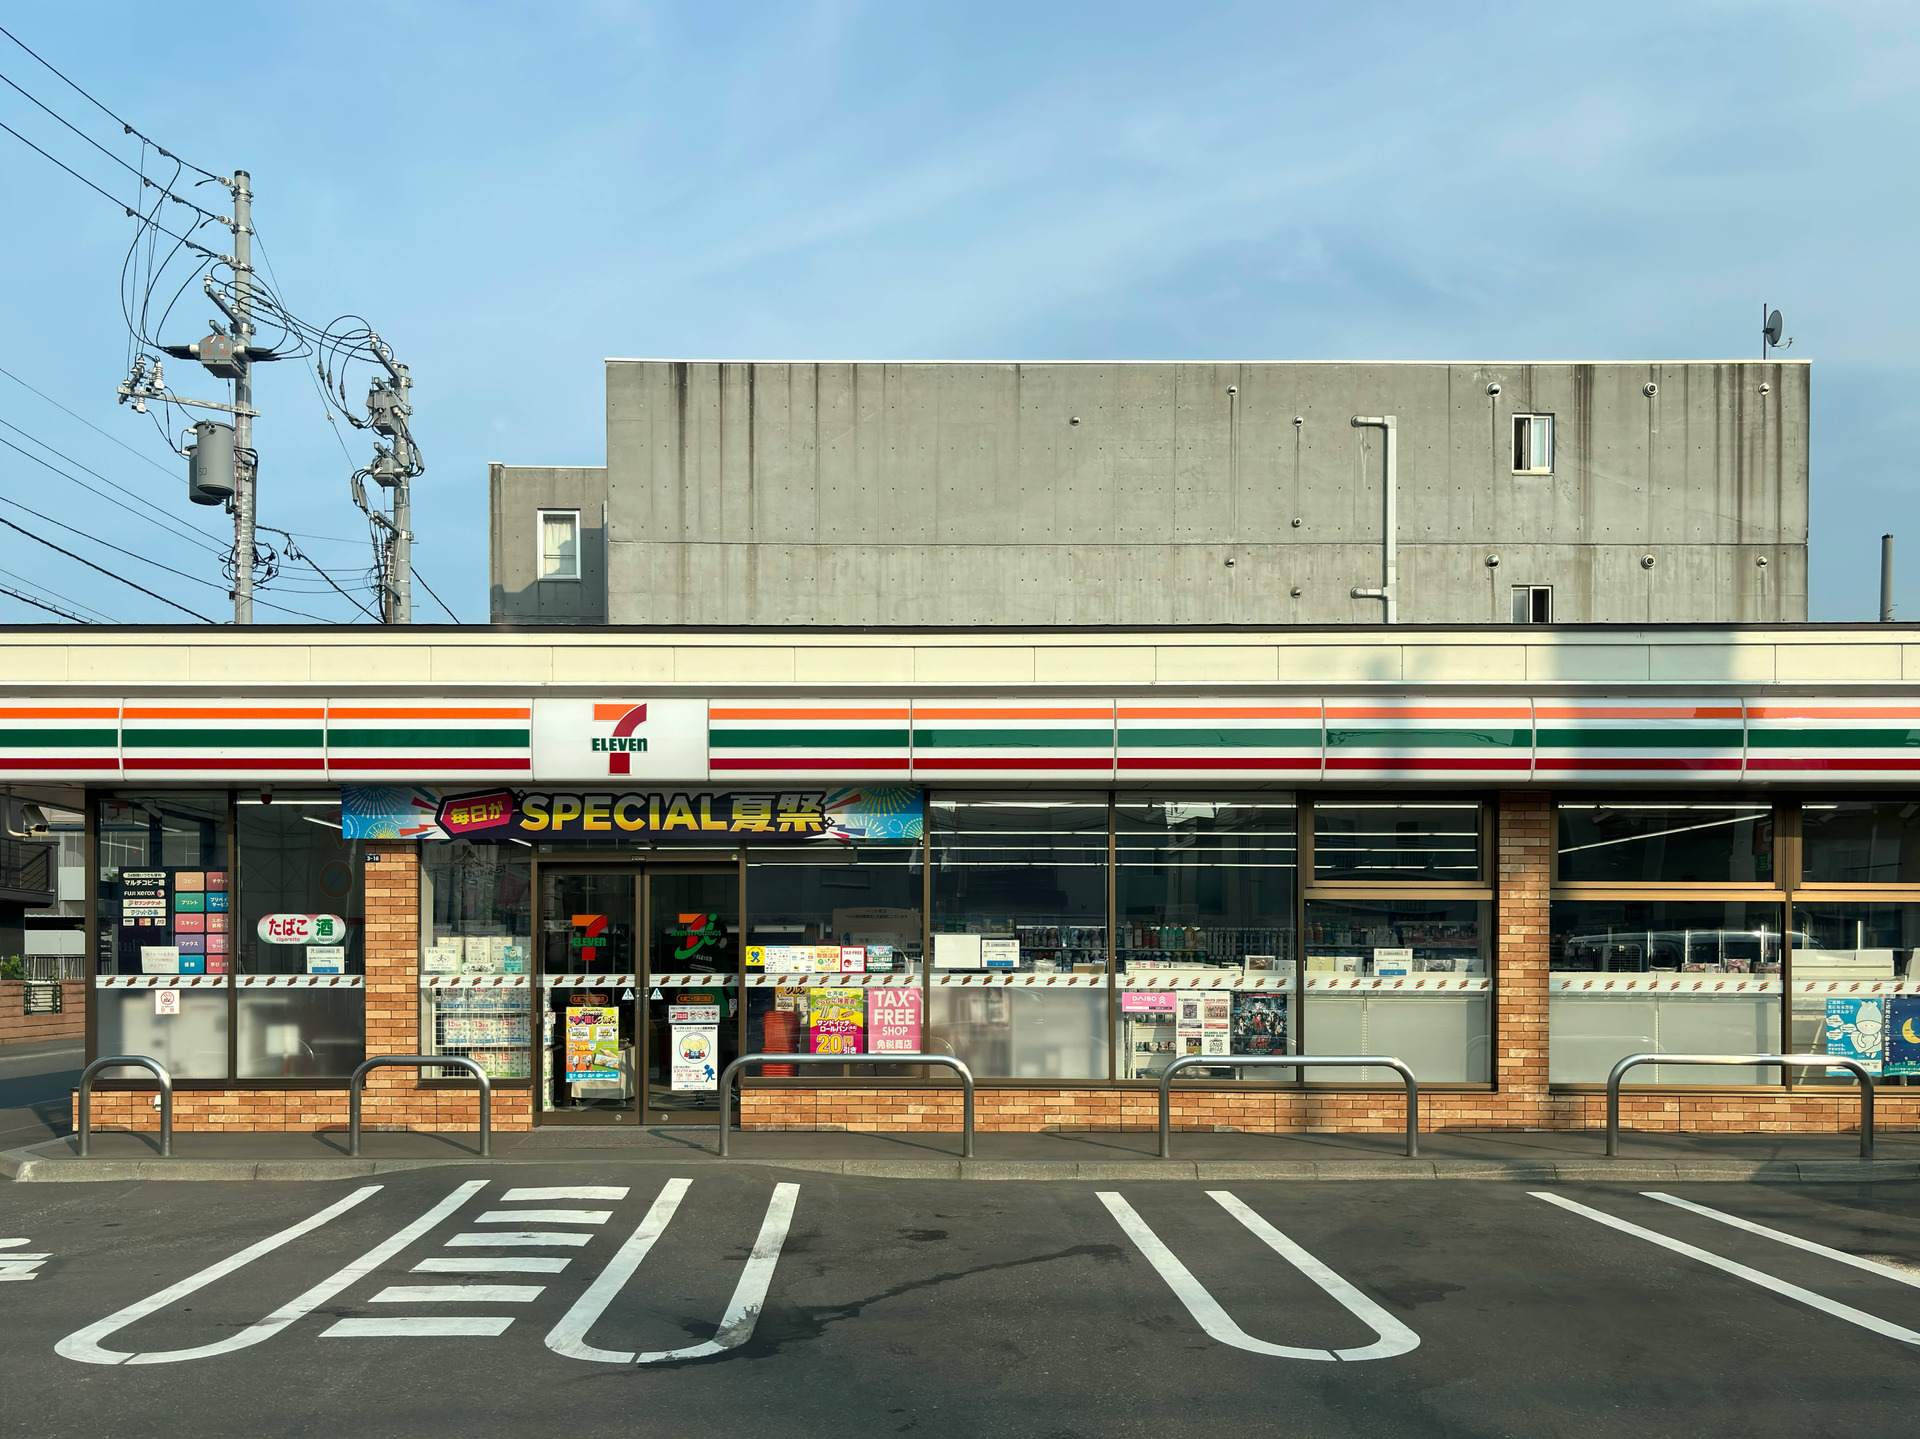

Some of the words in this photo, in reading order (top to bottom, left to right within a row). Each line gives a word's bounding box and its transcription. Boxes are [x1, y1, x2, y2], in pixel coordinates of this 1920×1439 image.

[450, 801, 504, 825] 毎日が
[269, 918, 308, 936] たばこ
[316, 918, 333, 936] 酒
[874, 991, 915, 1007] TAX-
[874, 1009, 915, 1025] FREE
[882, 1027, 908, 1036] SHOP
[816, 1034, 842, 1054] 20
[843, 1036, 854, 1046] 円
